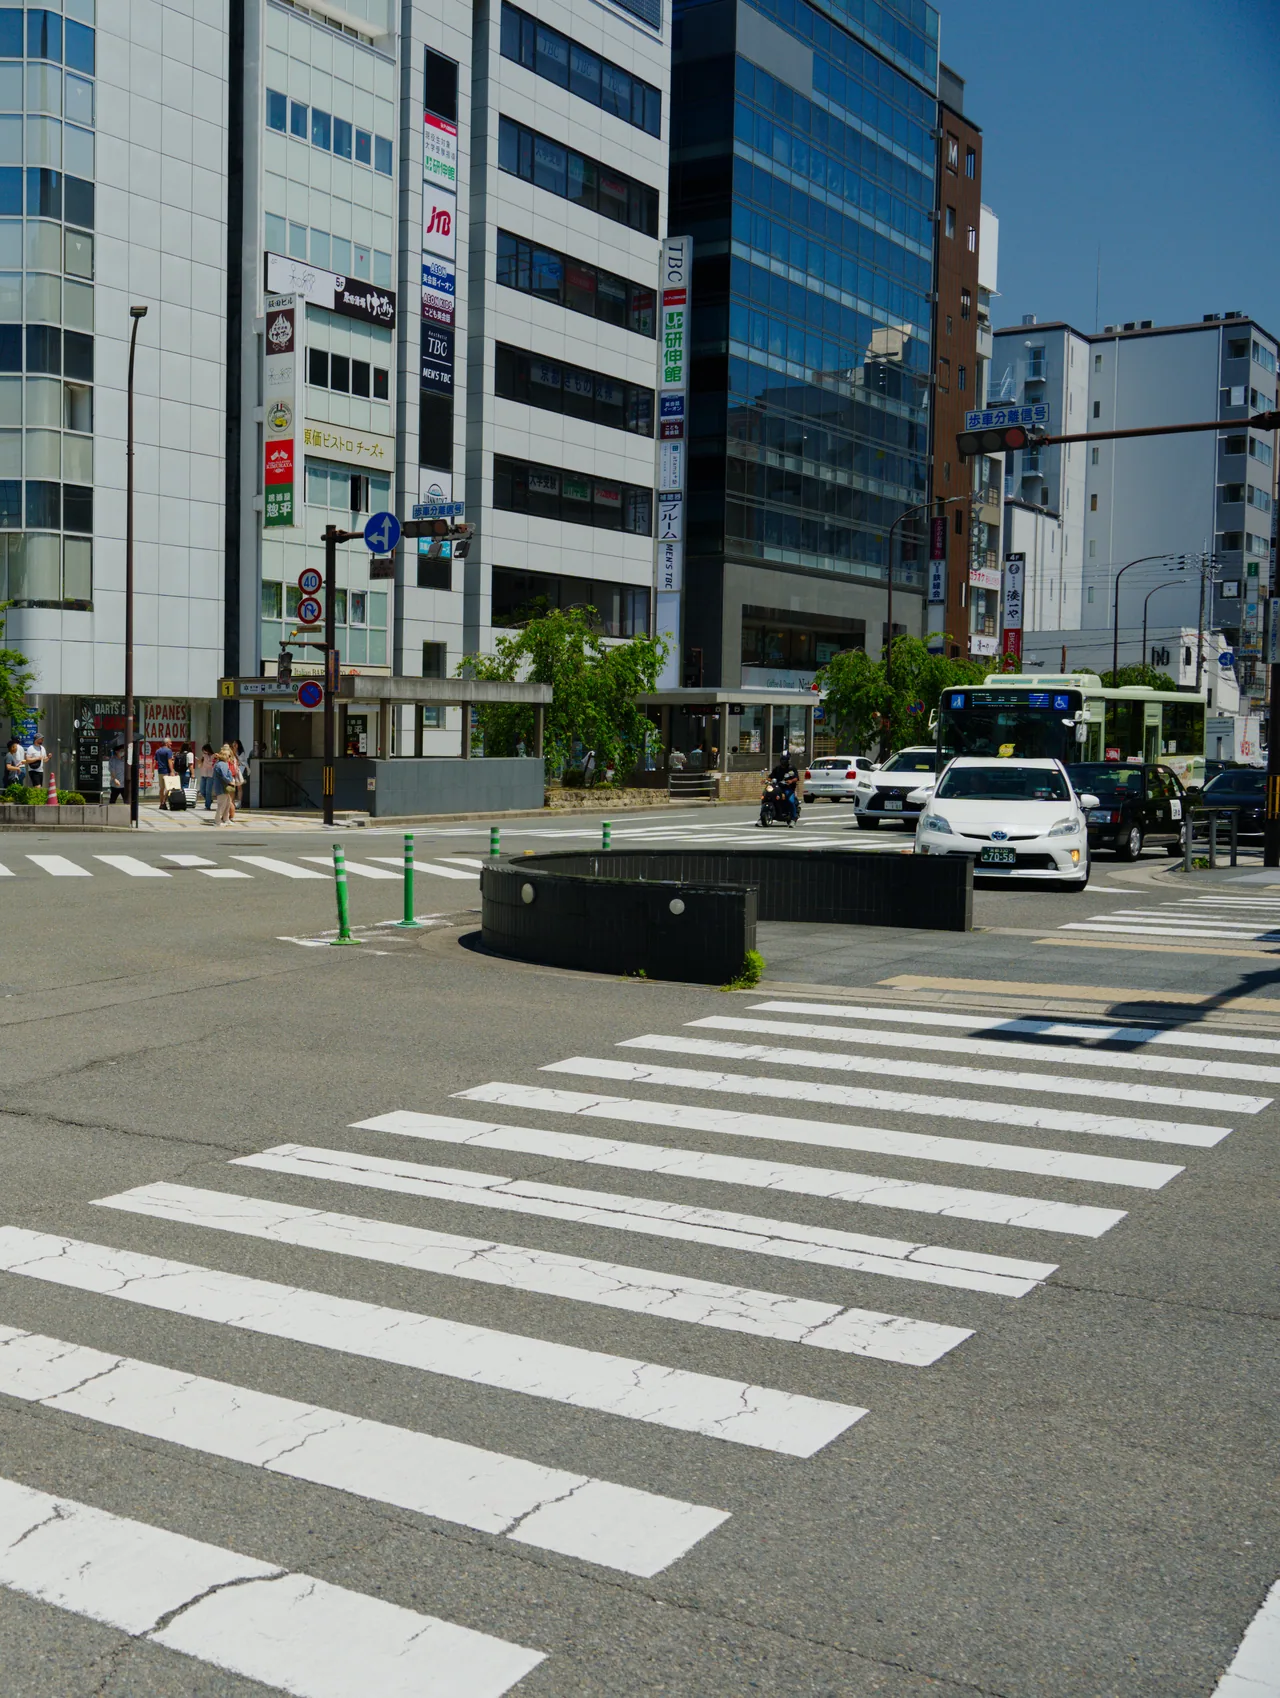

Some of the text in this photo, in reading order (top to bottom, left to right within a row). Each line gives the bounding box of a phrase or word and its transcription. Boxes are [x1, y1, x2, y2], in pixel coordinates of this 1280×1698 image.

[426, 206, 451, 236] JTB
[430, 263, 447, 278] AEON
[668, 243, 683, 282] TBC
[423, 274, 454, 292] 英会話イーオン
[423, 293, 440, 307] AEON
[424, 307, 451, 323] こども英会話
[428, 338, 447, 357] TBC
[664, 331, 682, 383] 研伸館
[423, 368, 451, 384] MEN'S TBC
[969, 406, 1046, 428] 歩車分離信号
[414, 503, 462, 516] 歩車分離信号
[661, 503, 679, 540] ブルーム
[303, 575, 317, 588] 40
[95, 704, 136, 715] DARTS BR
[989, 852, 1014, 863] 70-58
